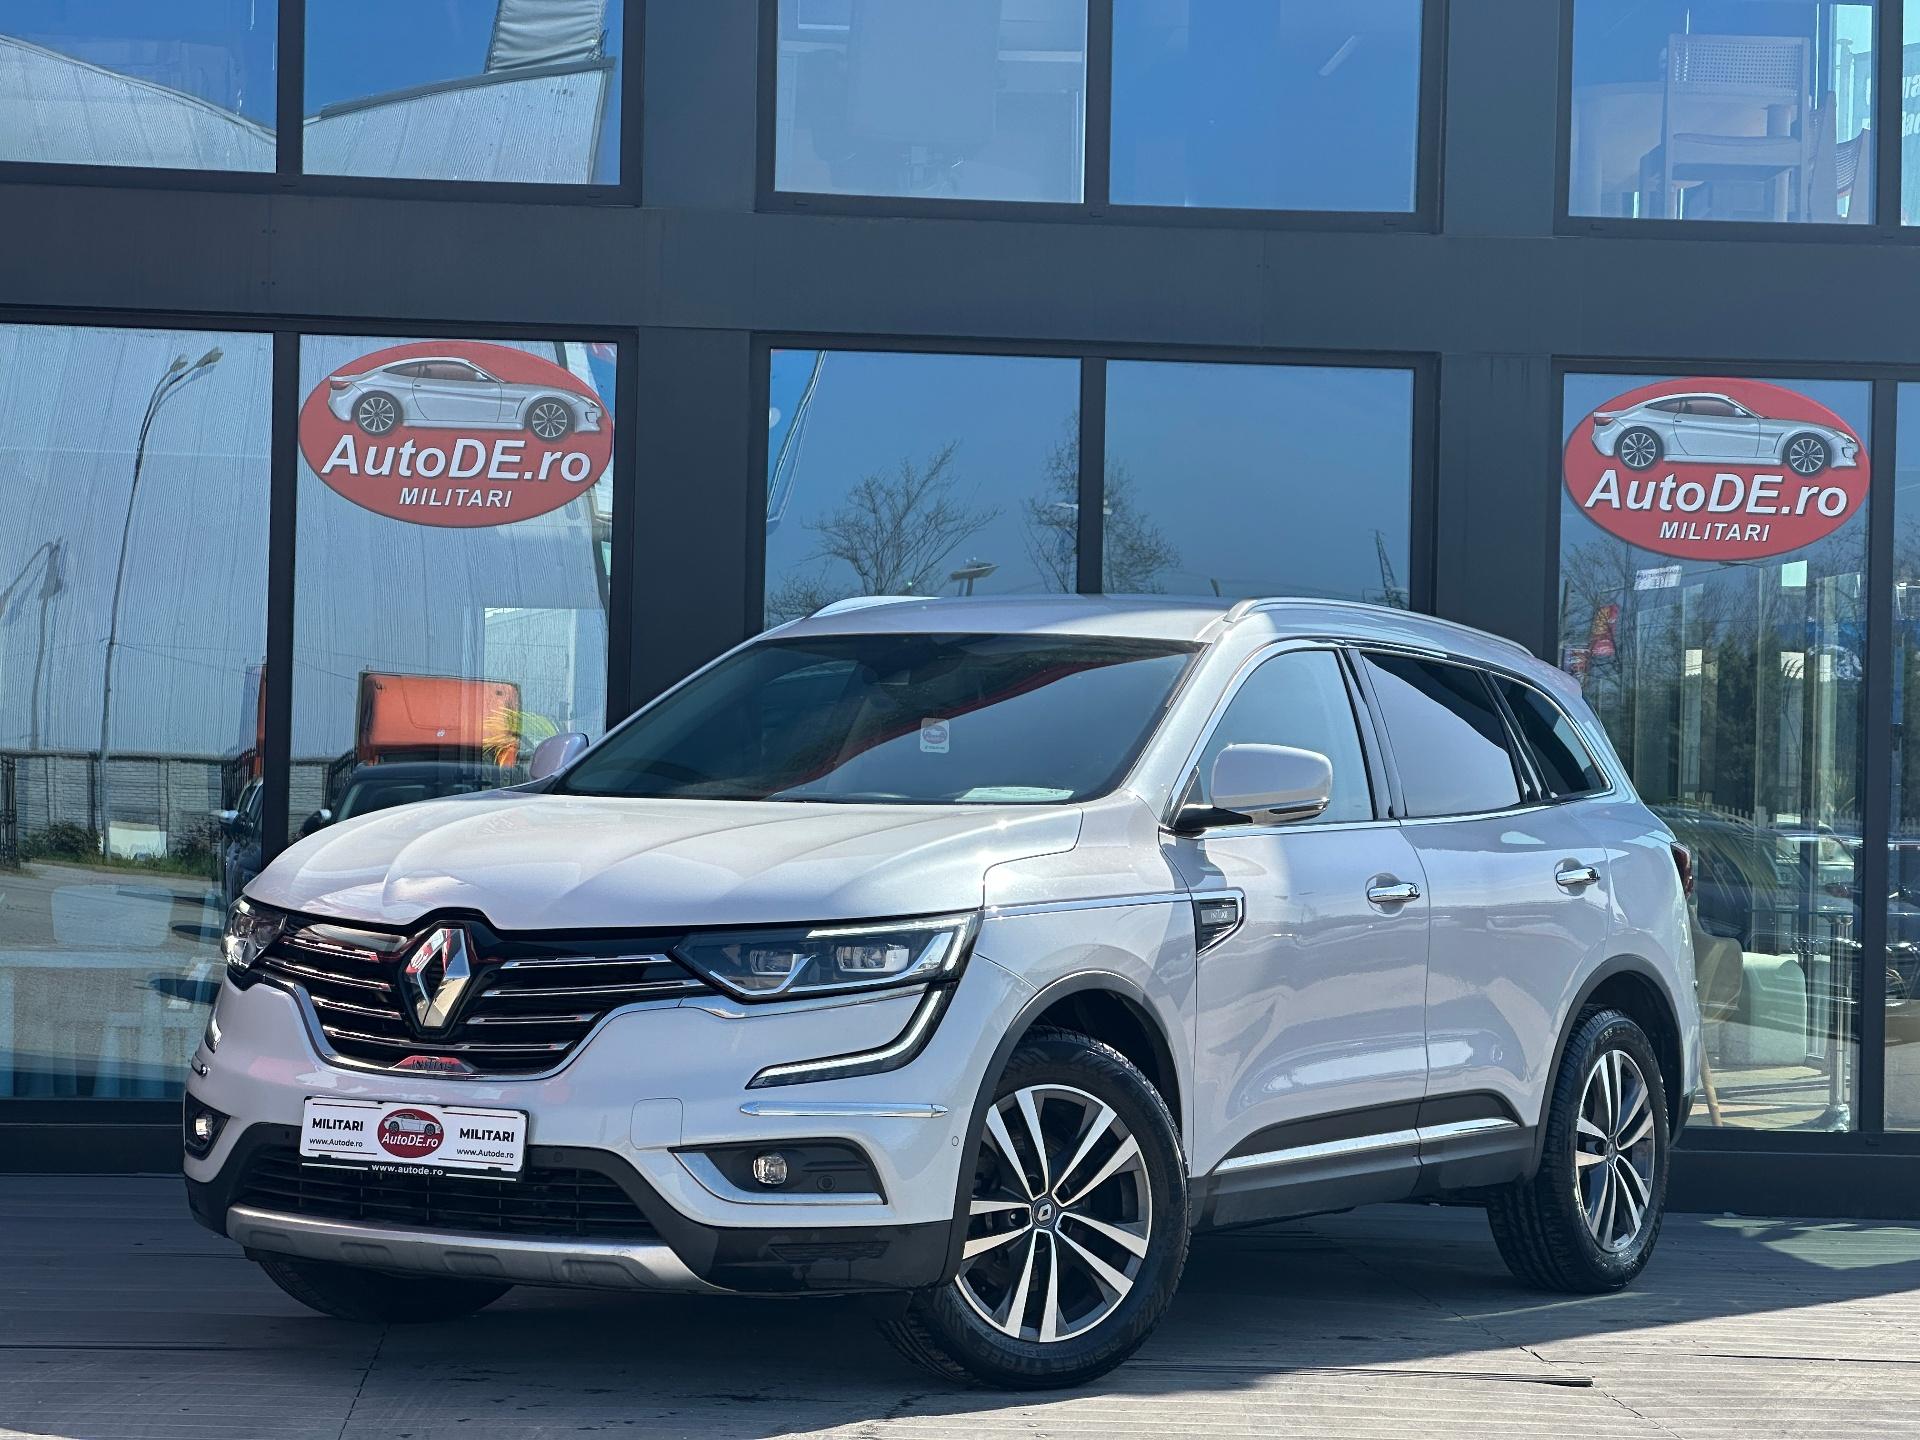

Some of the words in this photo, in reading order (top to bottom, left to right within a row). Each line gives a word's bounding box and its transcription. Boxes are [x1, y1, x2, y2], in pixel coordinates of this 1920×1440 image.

[321, 434, 591, 482] AutoDE.ro
[399, 486, 513, 508] MILITARI
[1585, 469, 1848, 518] AutoDE.ro
[1659, 521, 1771, 542] MILITARI
[312, 1118, 364, 1132] MILITARI
[381, 1134, 438, 1148] AutoDE.ro
[459, 1128, 515, 1142] MILITARI
[309, 1138, 363, 1148] www.Autode.ro
[456, 1148, 514, 1159] www.Autode.ro
[371, 1163, 444, 1176] www.autode.ro
